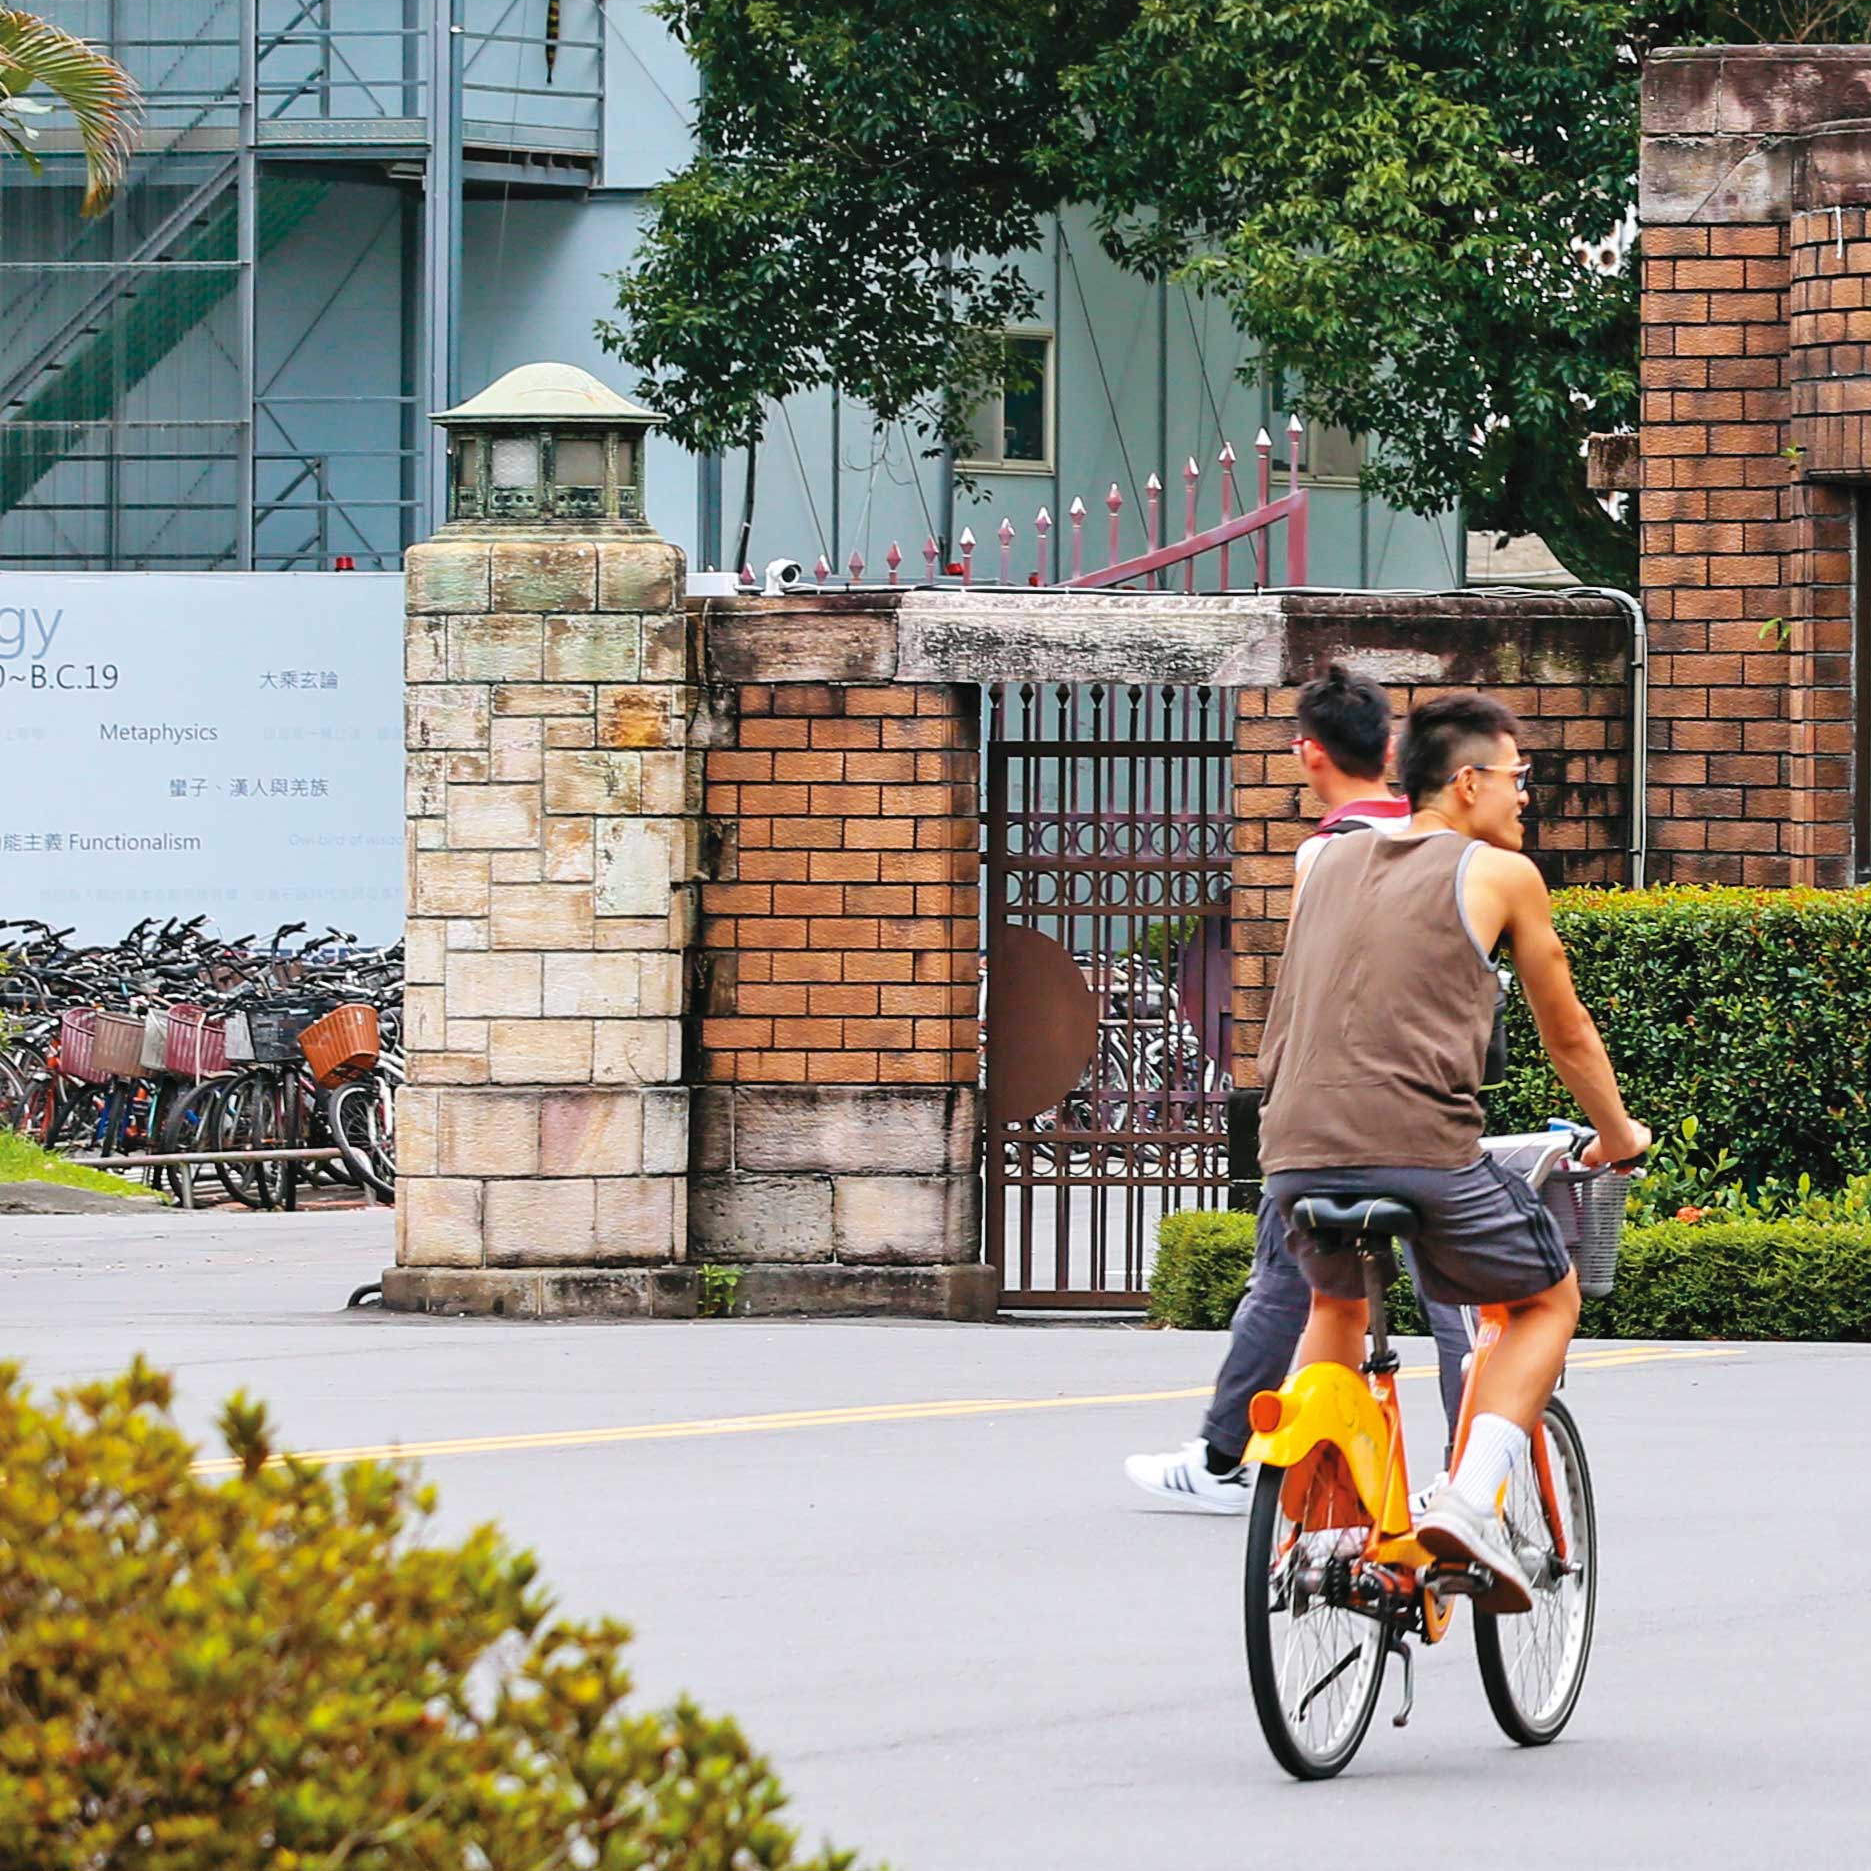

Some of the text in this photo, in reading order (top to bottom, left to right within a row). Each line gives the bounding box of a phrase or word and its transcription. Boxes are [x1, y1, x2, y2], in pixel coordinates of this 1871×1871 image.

[100, 723, 218, 743] Metaphysics
[0, 832, 201, 851] 能主義 Functionalism
